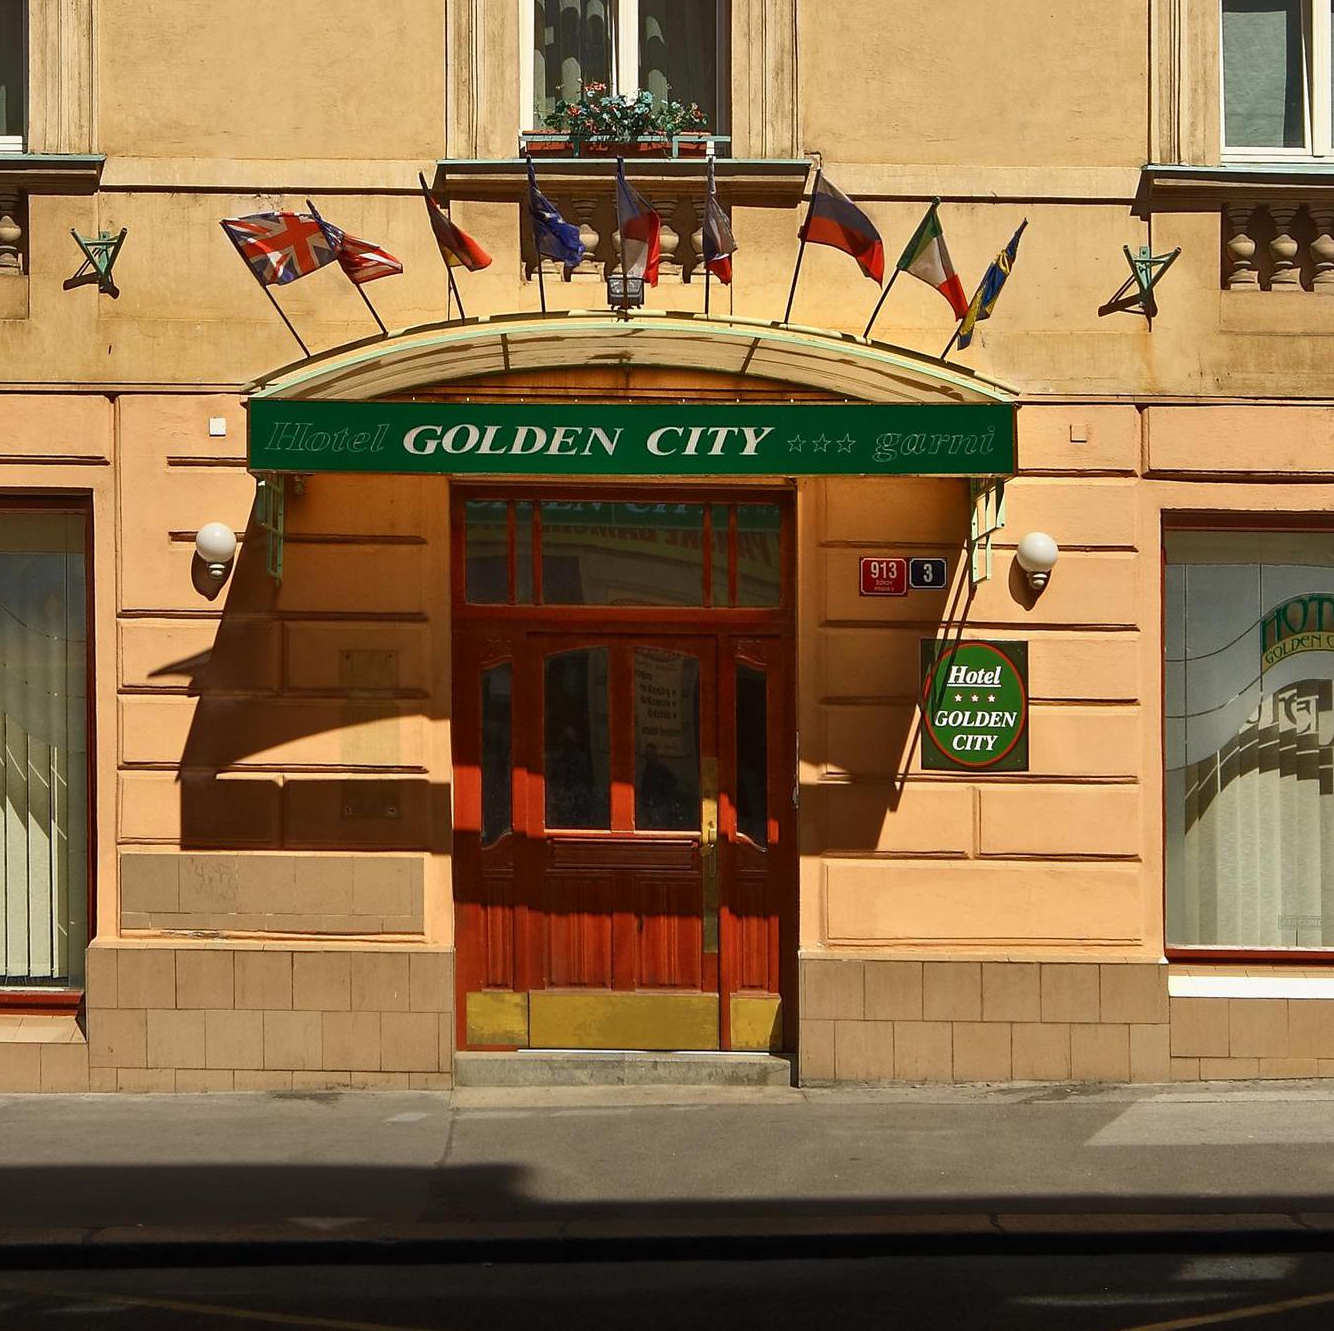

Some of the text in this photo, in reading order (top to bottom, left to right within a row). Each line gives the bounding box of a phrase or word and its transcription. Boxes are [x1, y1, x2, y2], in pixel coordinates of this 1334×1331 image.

[265, 422, 995, 462] Hotel GOLDEN CITY garni
[871, 562, 897, 579] 913
[923, 563, 933, 583] 3
[1266, 634, 1322, 664] GOLDEN
[947, 666, 1001, 685] Hotel
[935, 710, 1017, 728] GOLDEN
[952, 734, 998, 751] CITY
